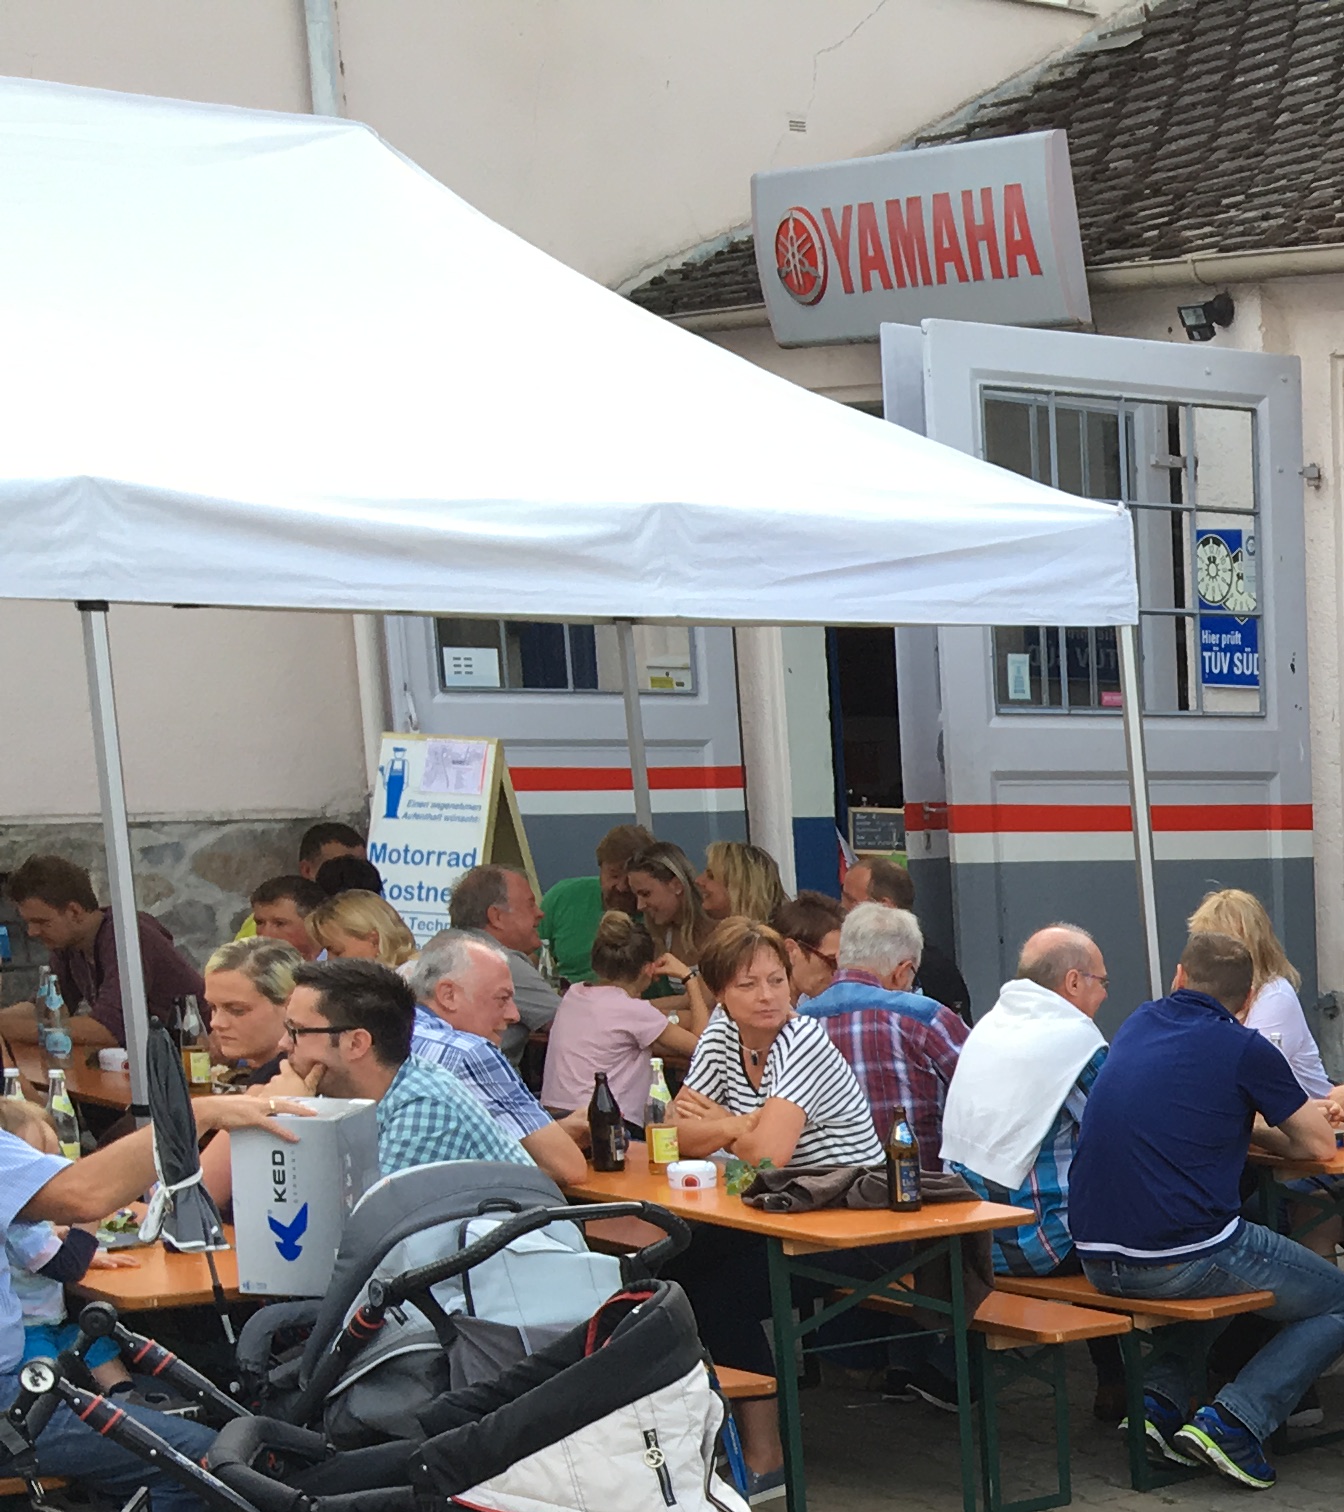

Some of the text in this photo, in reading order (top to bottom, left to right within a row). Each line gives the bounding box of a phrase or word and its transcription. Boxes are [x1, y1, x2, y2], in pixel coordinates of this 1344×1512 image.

[822, 183, 1043, 295] YAMAHA
[1202, 630, 1242, 648] Hier prüft
[1203, 646, 1230, 674] TÜV
[369, 842, 477, 868] Motorrad
[380, 878, 453, 904] ostne
[271, 1149, 288, 1204] KED
